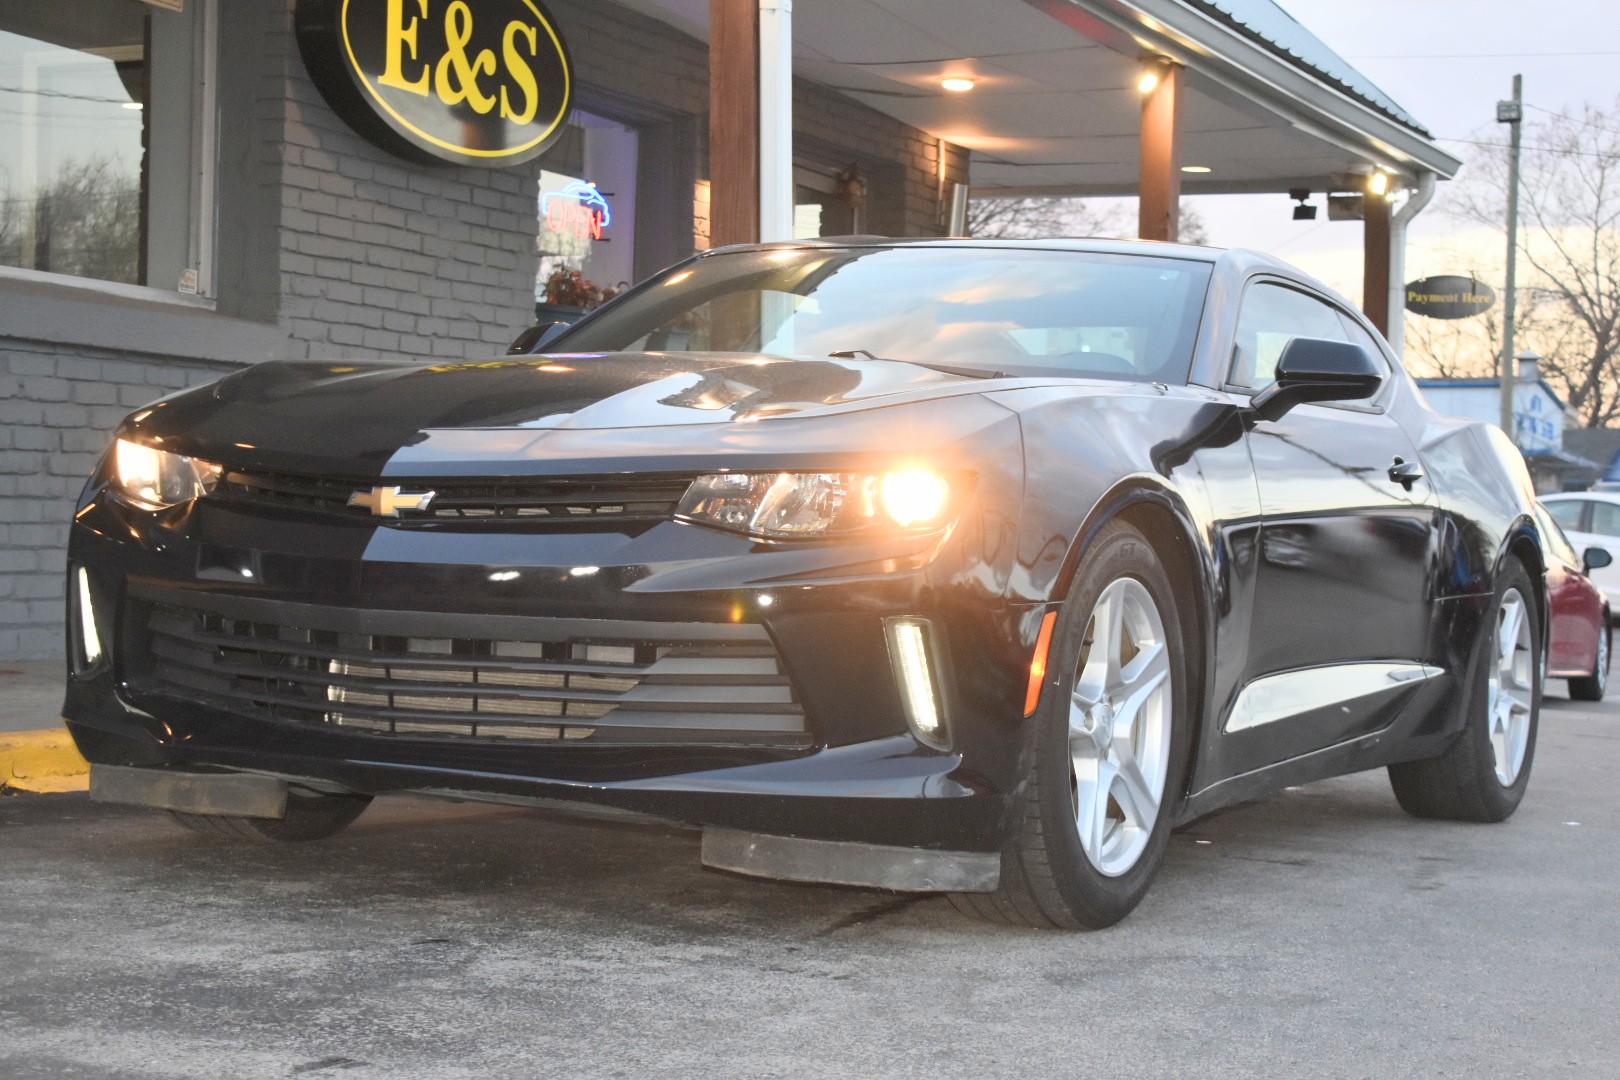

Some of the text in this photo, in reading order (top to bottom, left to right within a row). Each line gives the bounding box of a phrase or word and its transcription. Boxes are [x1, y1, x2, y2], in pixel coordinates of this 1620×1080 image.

[377, 0, 538, 125] E&S
[547, 200, 603, 240] OPEN
[1408, 291, 1491, 304] Payment Here
